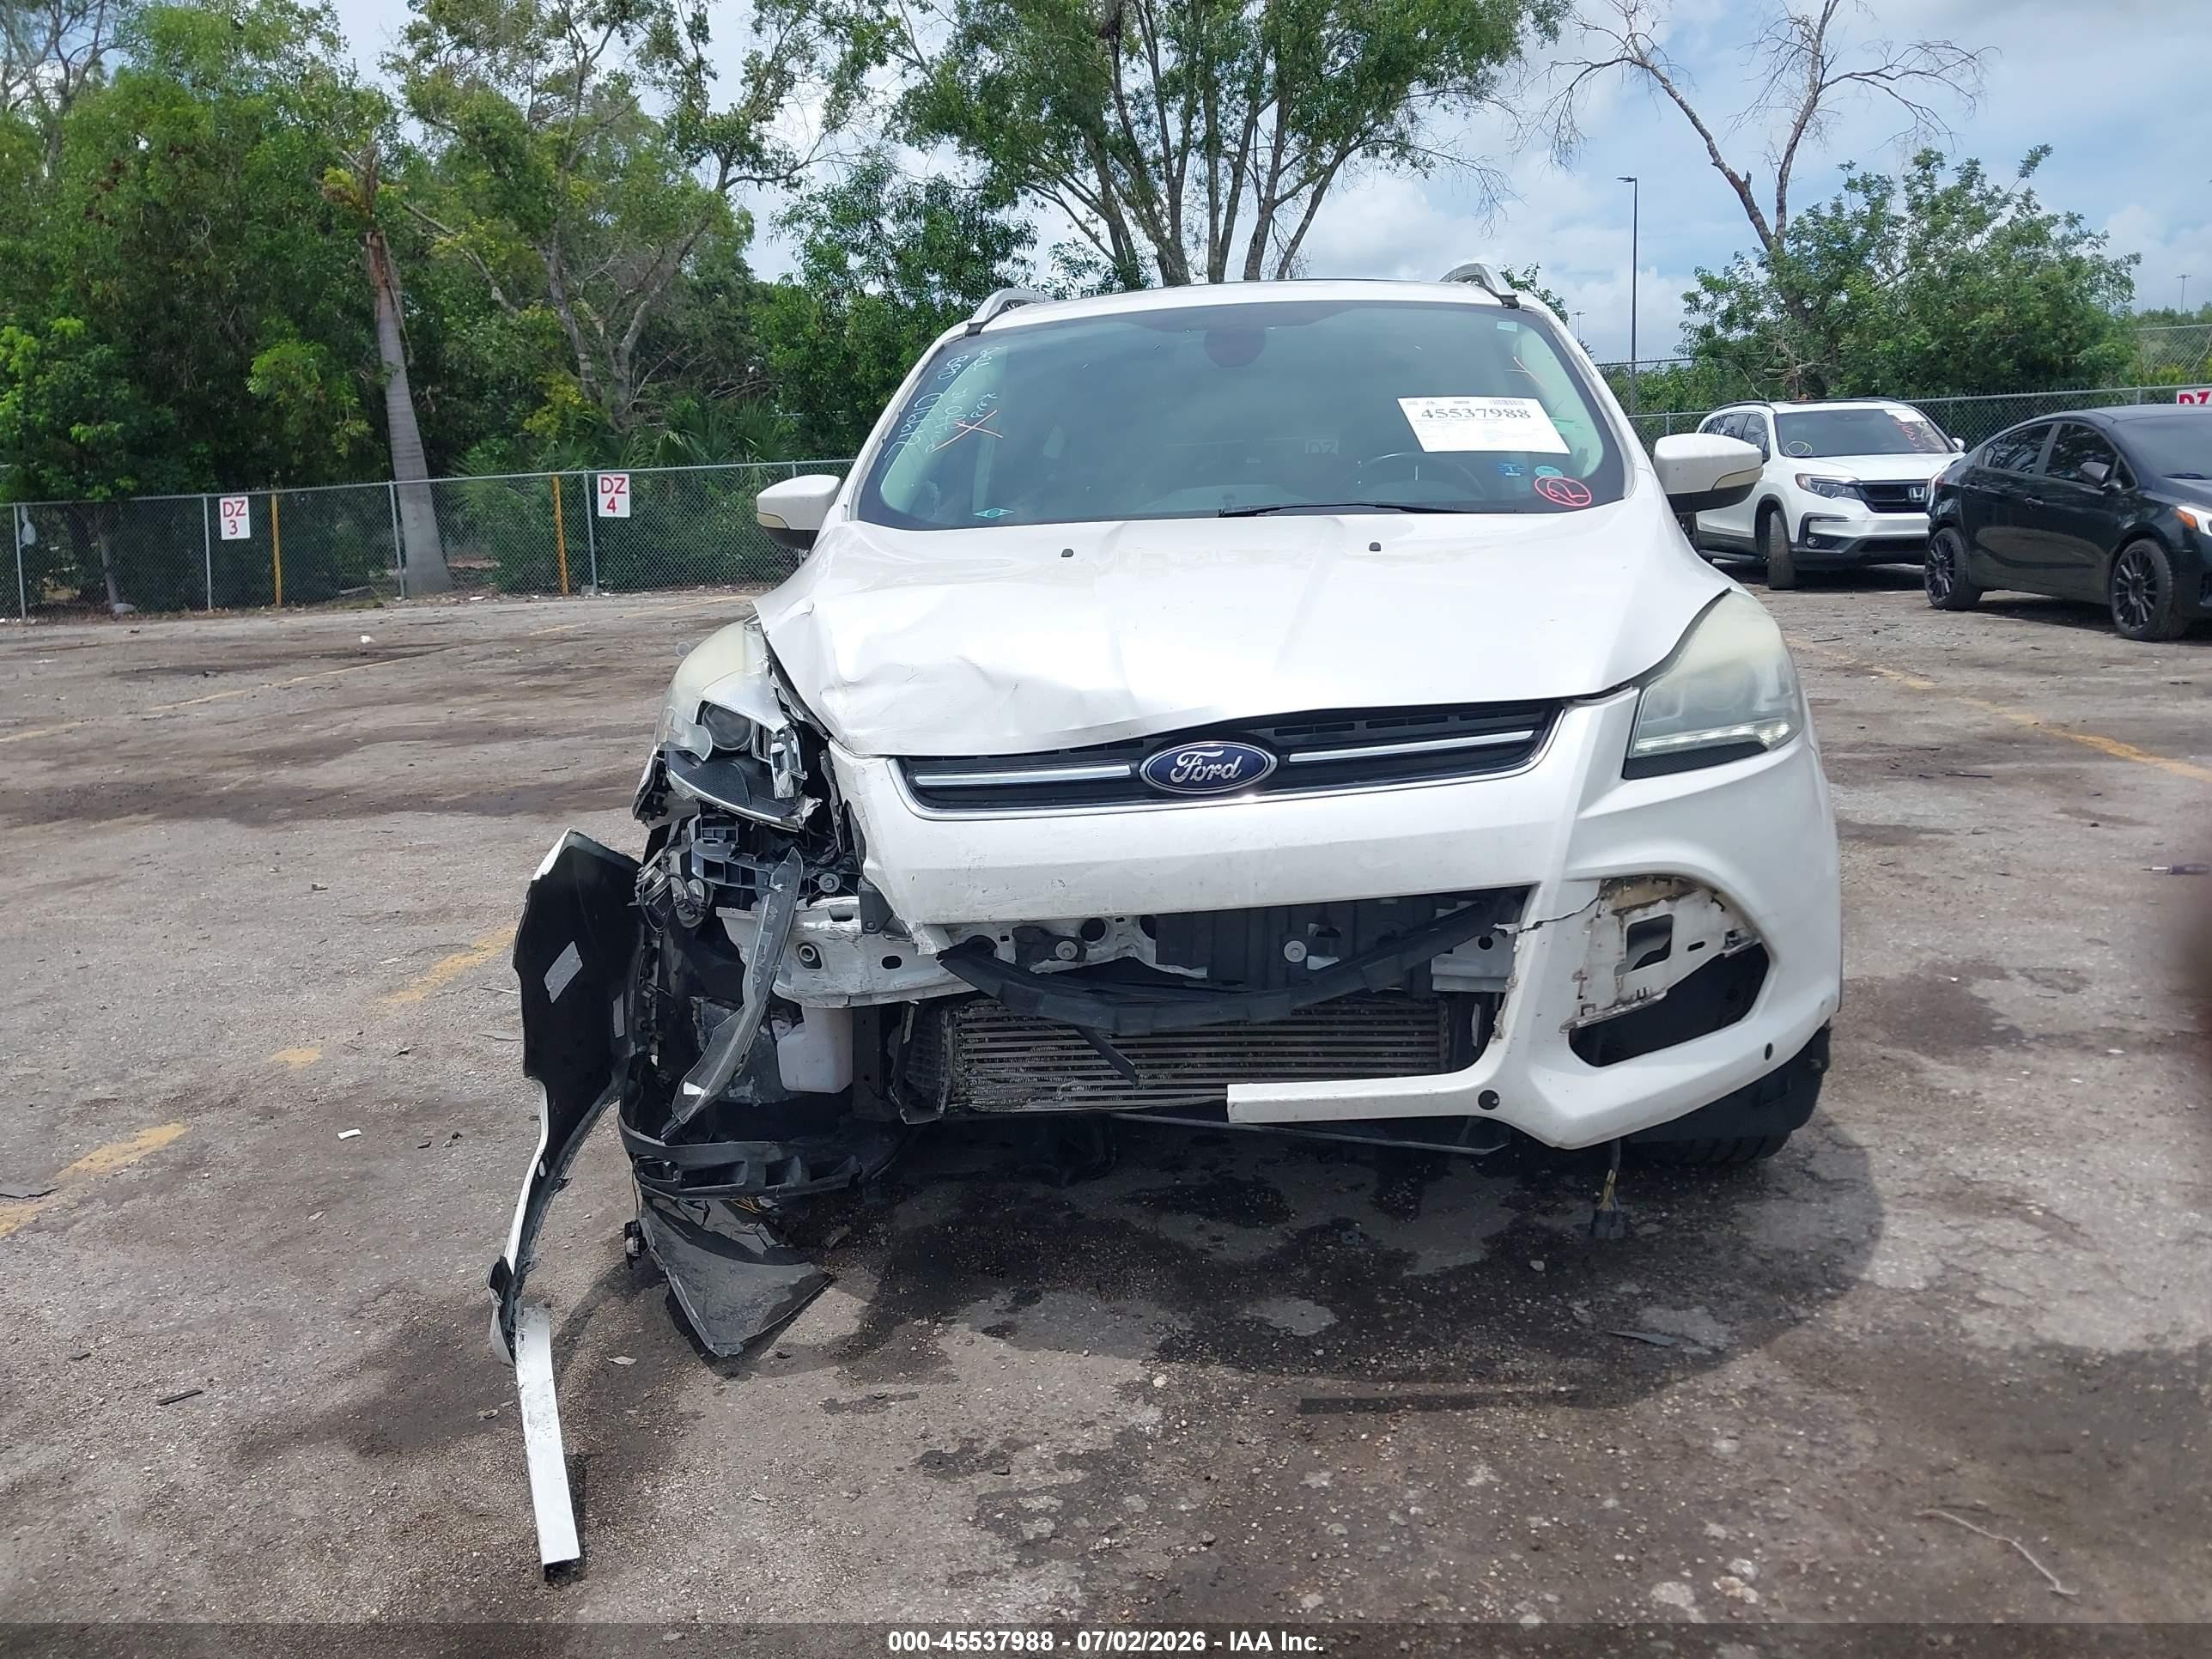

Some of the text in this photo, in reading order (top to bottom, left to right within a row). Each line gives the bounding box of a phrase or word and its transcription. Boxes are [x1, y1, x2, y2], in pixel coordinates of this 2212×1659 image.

[1421, 408, 1532, 419] 45537988
[600, 477, 627, 495] DZ
[222, 500, 247, 518] DZ
[606, 496, 617, 514] 4
[228, 520, 239, 535] 3
[1170, 750, 1243, 783] Ford
